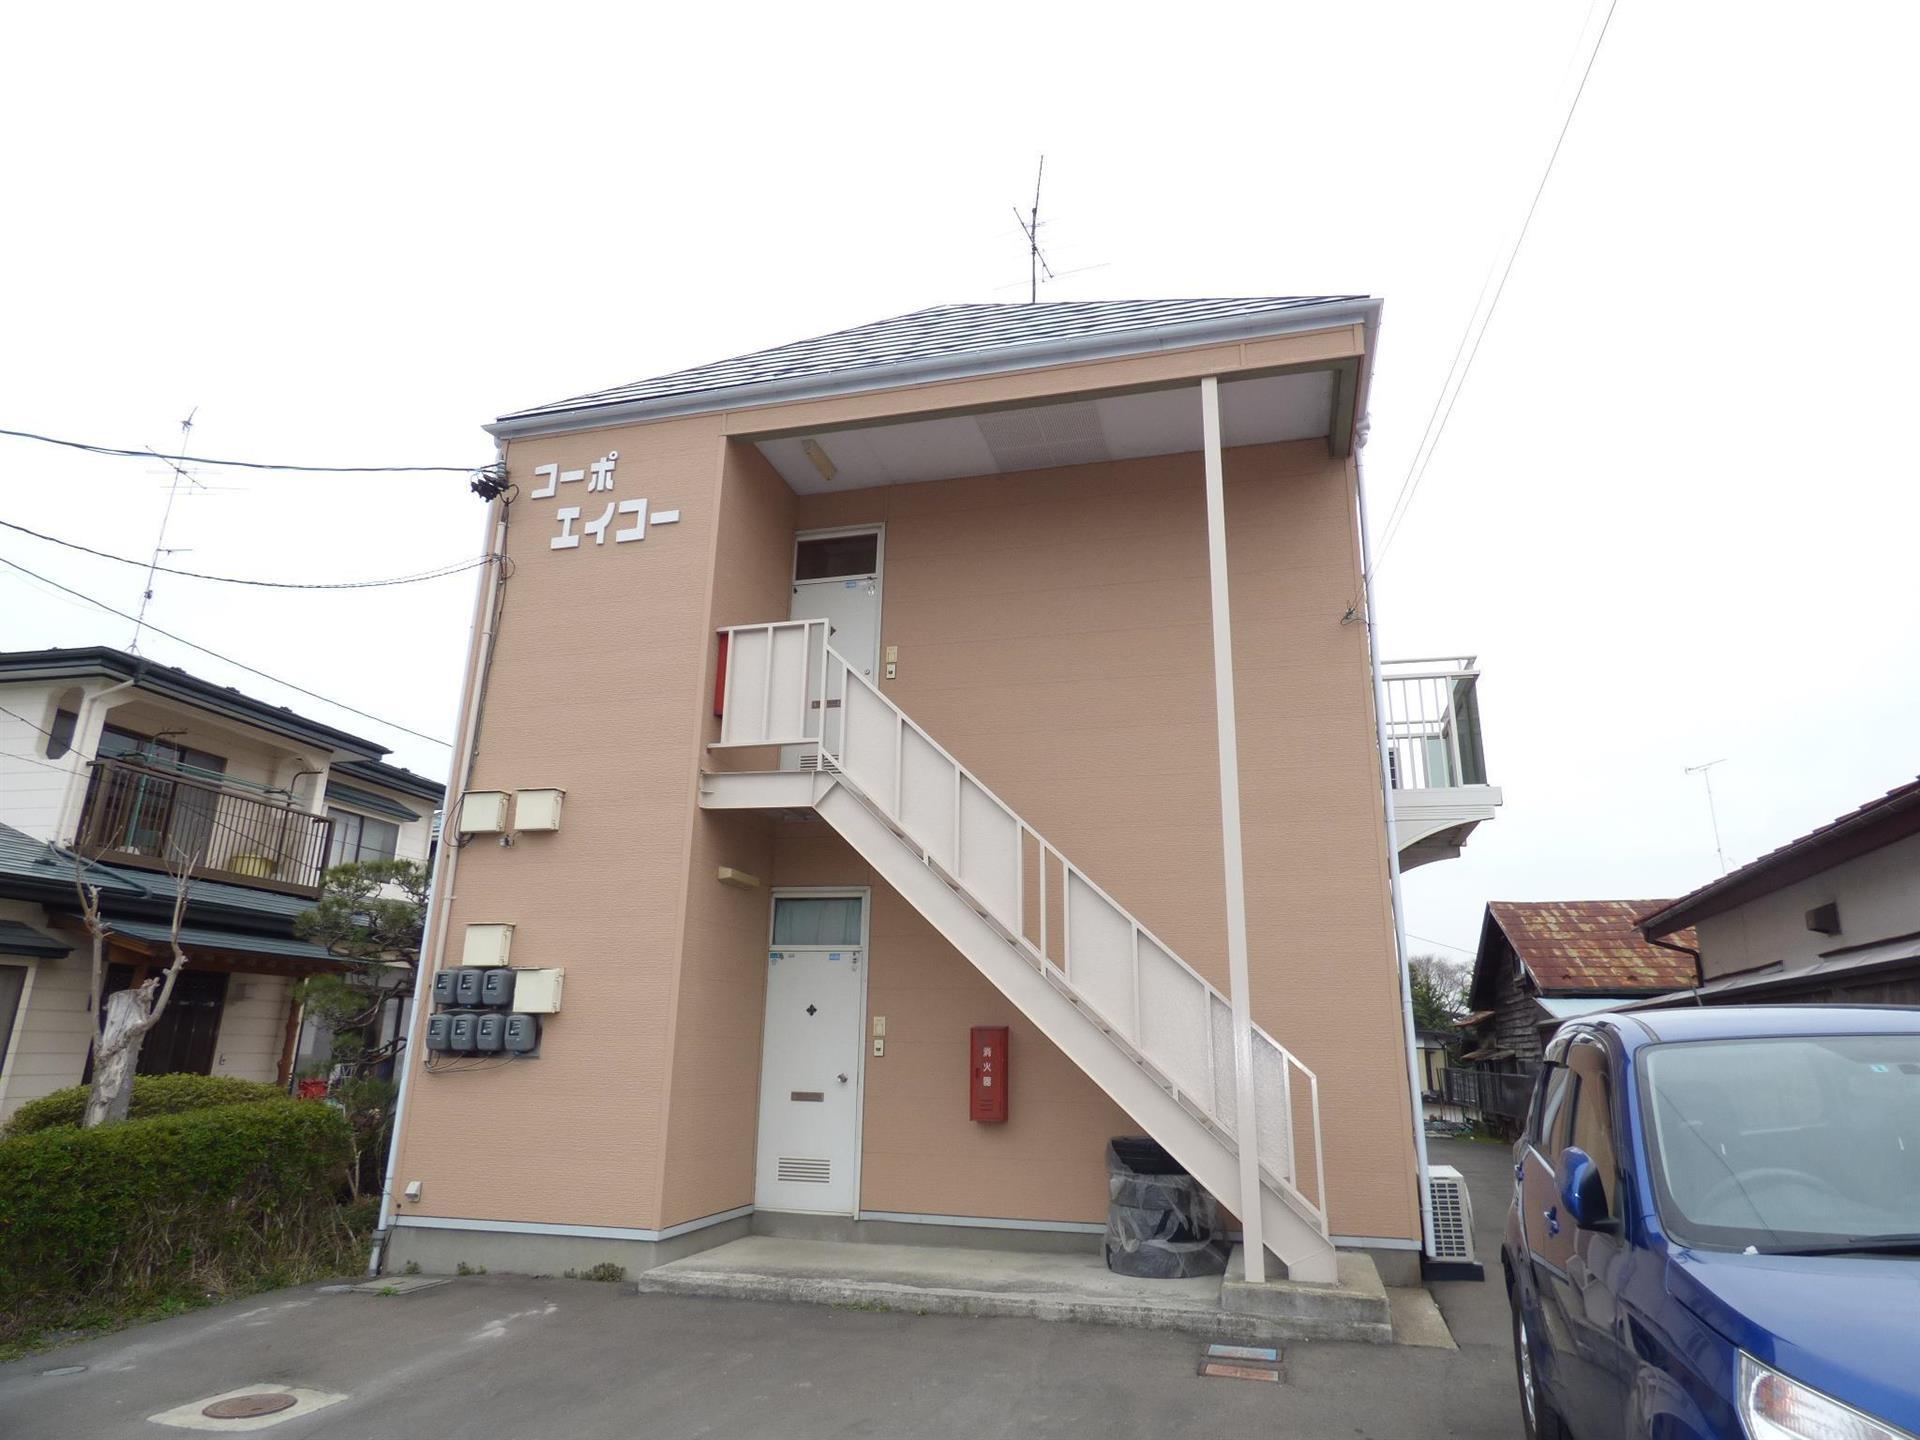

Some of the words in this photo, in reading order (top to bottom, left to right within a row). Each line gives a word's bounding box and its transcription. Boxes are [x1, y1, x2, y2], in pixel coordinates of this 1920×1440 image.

[531, 451, 618, 499] コーポ
[551, 498, 680, 550] エイコー
[983, 1047, 992, 1087] 消火器
